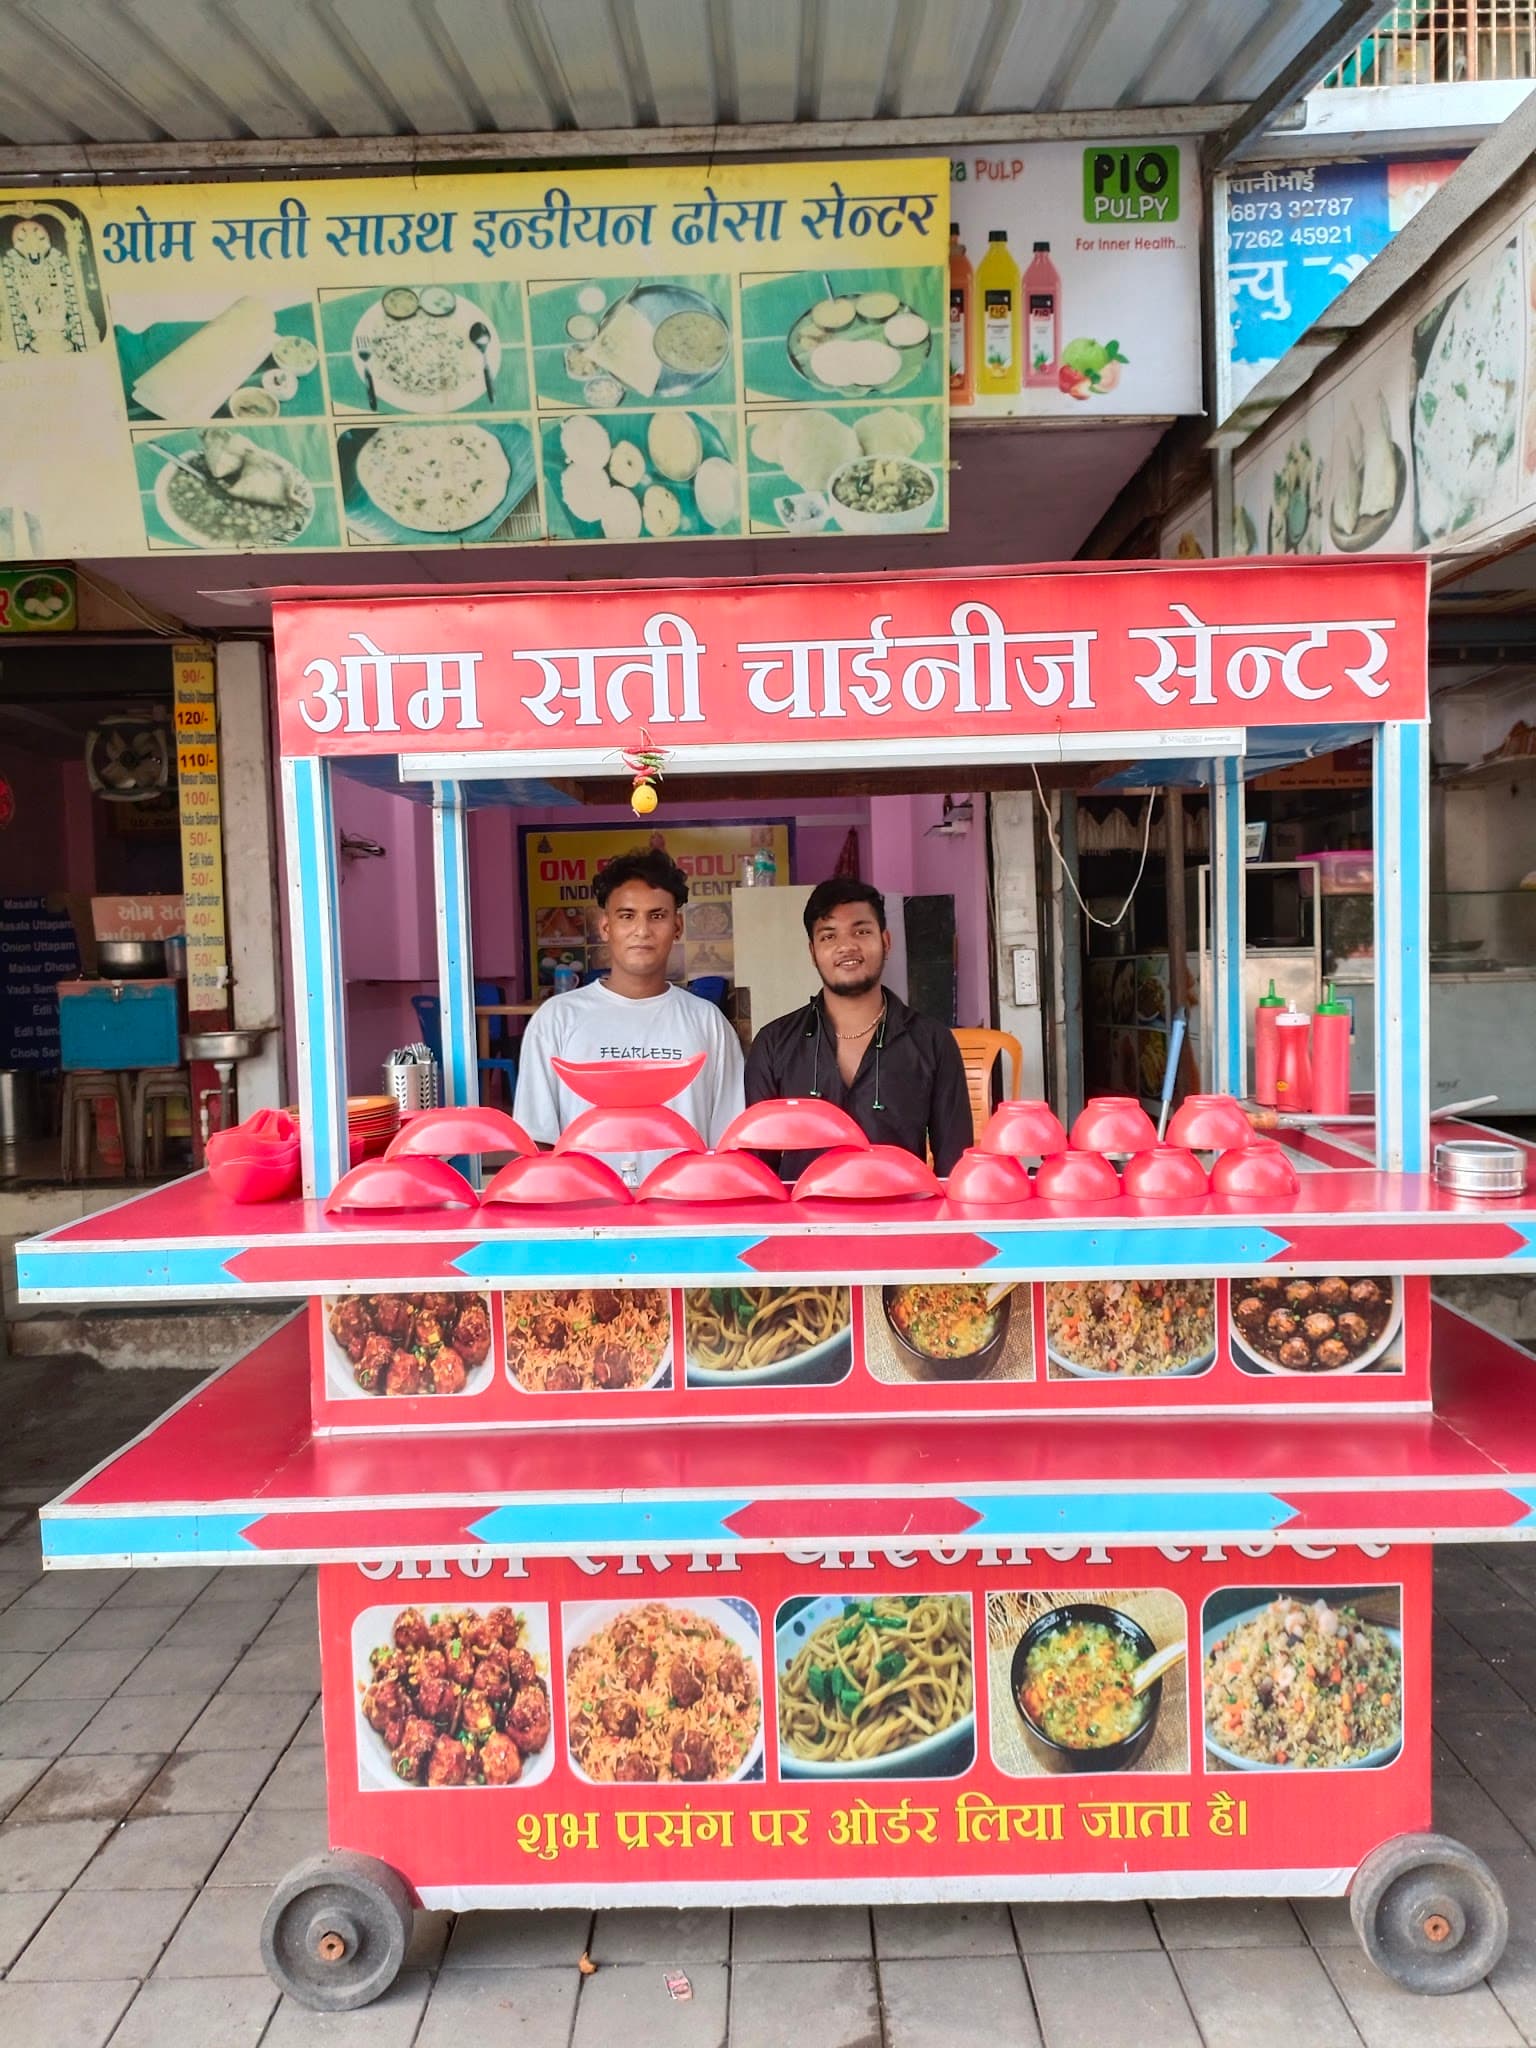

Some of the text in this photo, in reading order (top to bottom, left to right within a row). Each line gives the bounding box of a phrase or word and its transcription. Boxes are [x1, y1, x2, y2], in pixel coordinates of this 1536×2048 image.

[975, 158, 1024, 182] PULP
[1093, 151, 1169, 194] PIO
[1093, 195, 1170, 220] PULPY
[1227, 197, 1353, 223] 6873 32787
[102, 181, 937, 265] ओम सती साउथ इन्डीयन ढोसा सेन्टर
[1076, 238, 1094, 251] For
[1099, 238, 1130, 251] Inner
[1227, 225, 1352, 250] 7262 45921
[181, 669, 206, 684] 90/-
[298, 601, 1396, 734] ओम सती चाईनीज सेन्टर
[177, 711, 209, 725] 120/-
[180, 753, 214, 768] 110/-
[184, 791, 215, 806] 100/-
[190, 832, 213, 847] 50/-
[541, 858, 587, 881] OM
[676, 853, 755, 877] SOUT
[191, 872, 214, 887] 50/-
[692, 880, 745, 897] CENT
[599, 1046, 683, 1060] FEARLESS
[515, 1810, 599, 1860] शुभ
[614, 1802, 735, 1851] प्रसंग
[748, 1808, 811, 1847] पर
[827, 1797, 940, 1847] ओर्डर
[954, 1790, 1066, 1843] लिया
[1077, 1800, 1192, 1840] जाता
